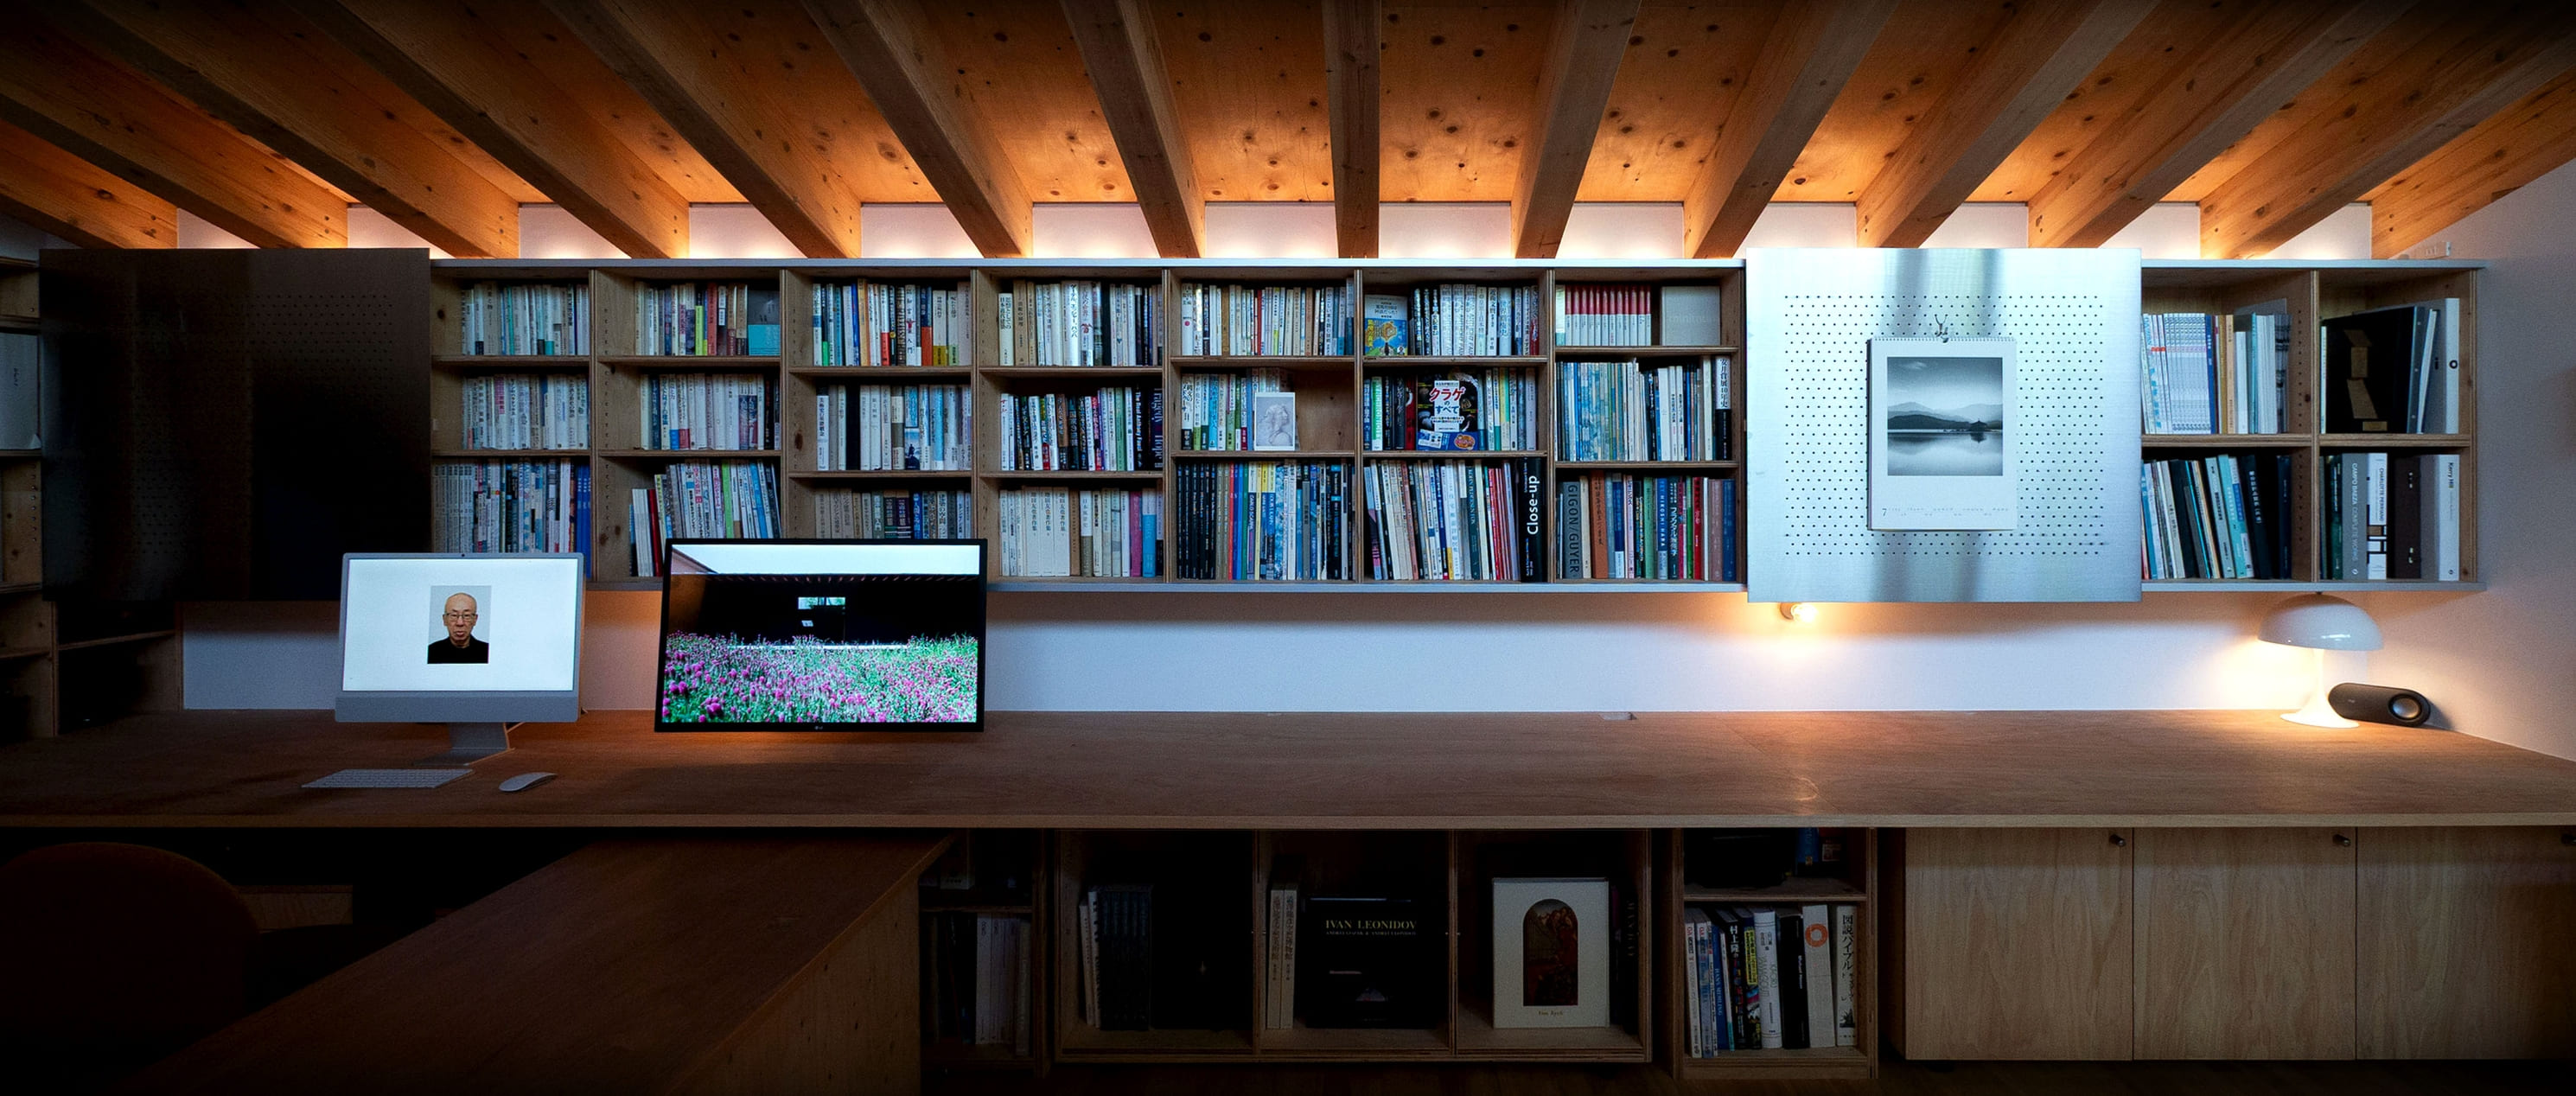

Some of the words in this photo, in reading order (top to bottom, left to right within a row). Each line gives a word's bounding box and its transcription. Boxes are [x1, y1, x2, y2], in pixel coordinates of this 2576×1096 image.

[1430, 387, 1466, 402] クラゲ
[1436, 405, 1459, 414] すべて
[1527, 475, 1540, 535] Close-up
[1566, 484, 1580, 574] GIGON/GUYER
[1325, 920, 1352, 929] IVAN
[1358, 920, 1417, 929] LEONIDOV
